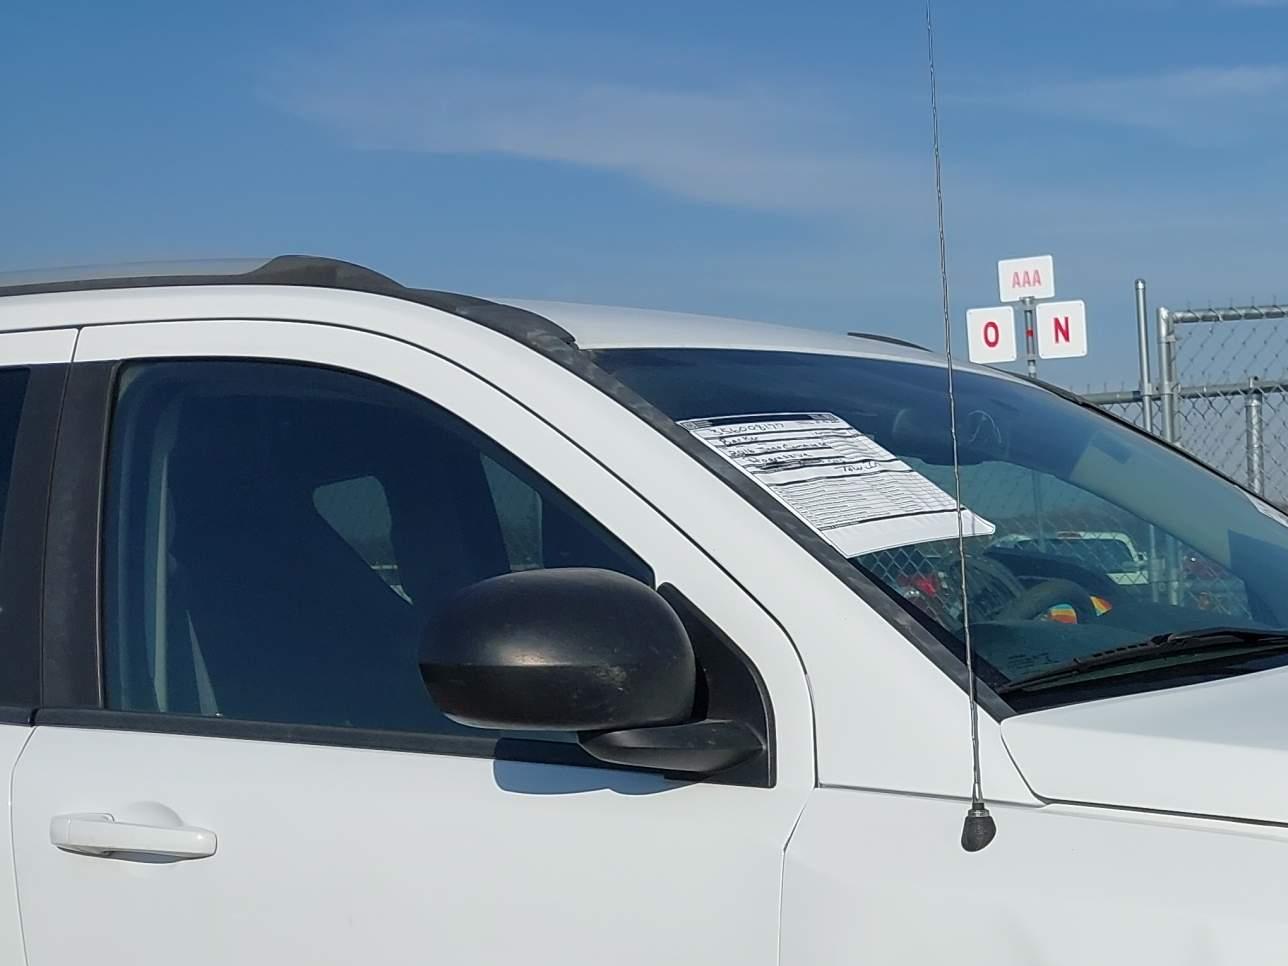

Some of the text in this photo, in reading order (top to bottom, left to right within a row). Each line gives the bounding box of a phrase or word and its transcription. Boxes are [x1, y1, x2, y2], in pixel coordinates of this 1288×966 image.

[1012, 269, 1042, 288] AAA
[983, 321, 999, 347] O
[1054, 317, 1070, 343] N
